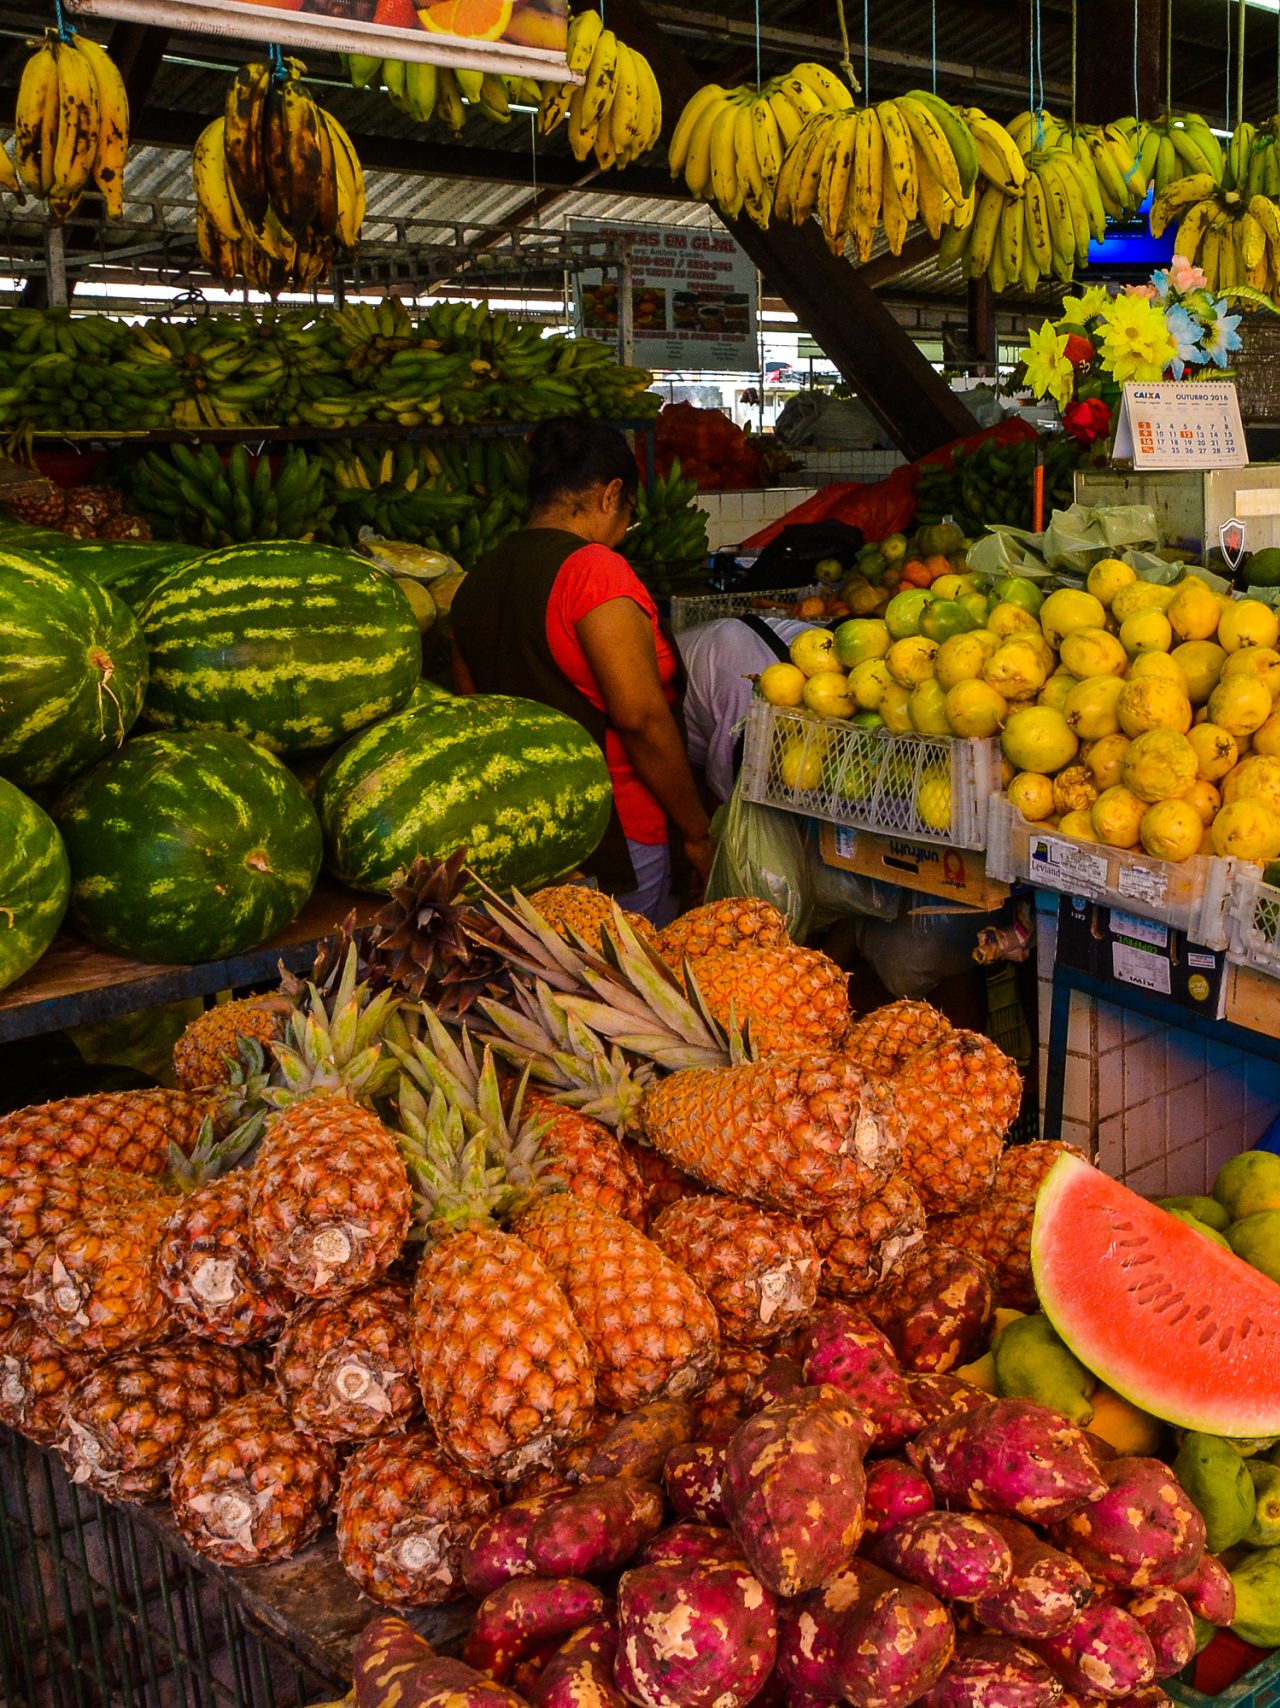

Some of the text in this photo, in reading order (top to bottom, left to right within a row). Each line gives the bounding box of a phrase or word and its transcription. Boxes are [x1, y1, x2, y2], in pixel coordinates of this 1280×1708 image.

[664, 233, 687, 250] EM
[890, 841, 939, 864] unifrutti
[1129, 976, 1155, 988] KIWI
